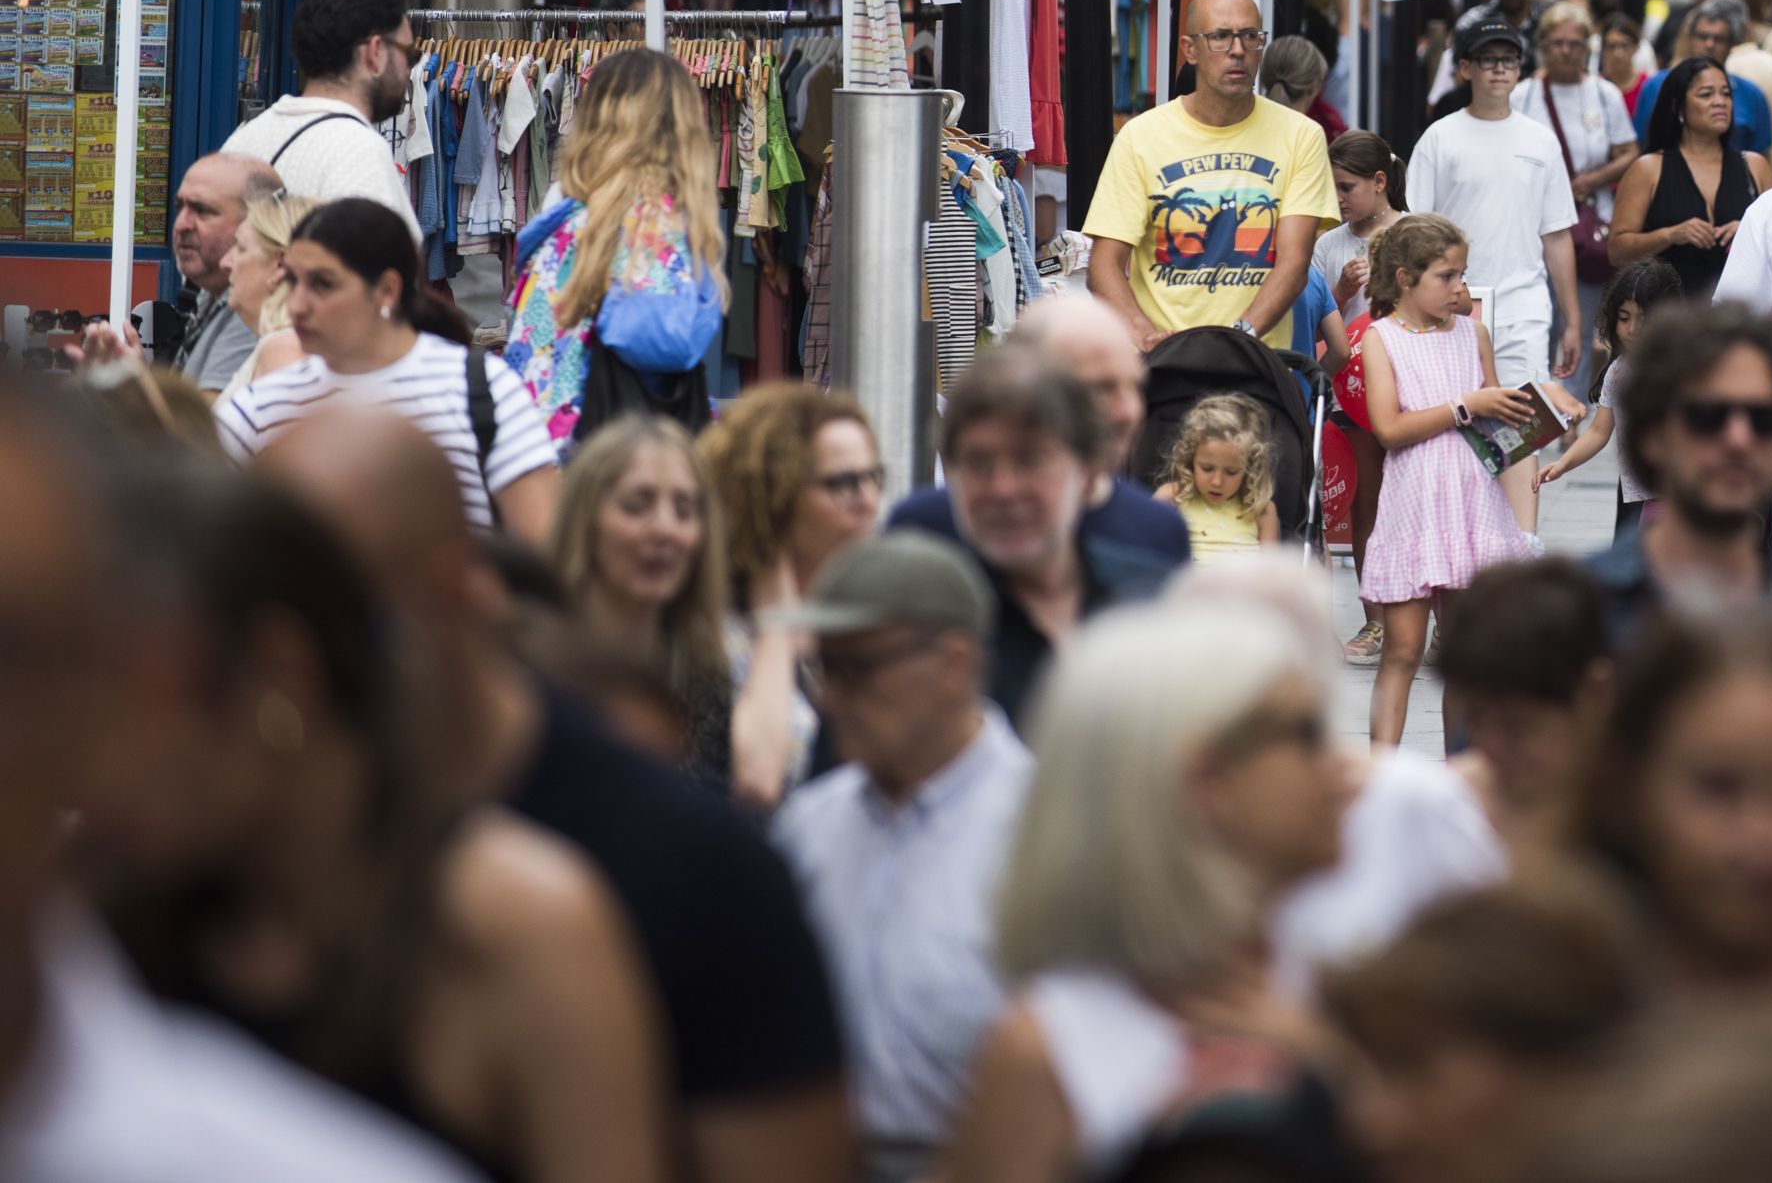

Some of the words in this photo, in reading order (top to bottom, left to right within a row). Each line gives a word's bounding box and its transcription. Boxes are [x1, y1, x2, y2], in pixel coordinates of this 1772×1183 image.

[768, 13, 783, 21] 1M
[1181, 155, 1217, 176] PEW
[1221, 153, 1255, 170] PEW
[1149, 262, 1265, 293] Madafaka
